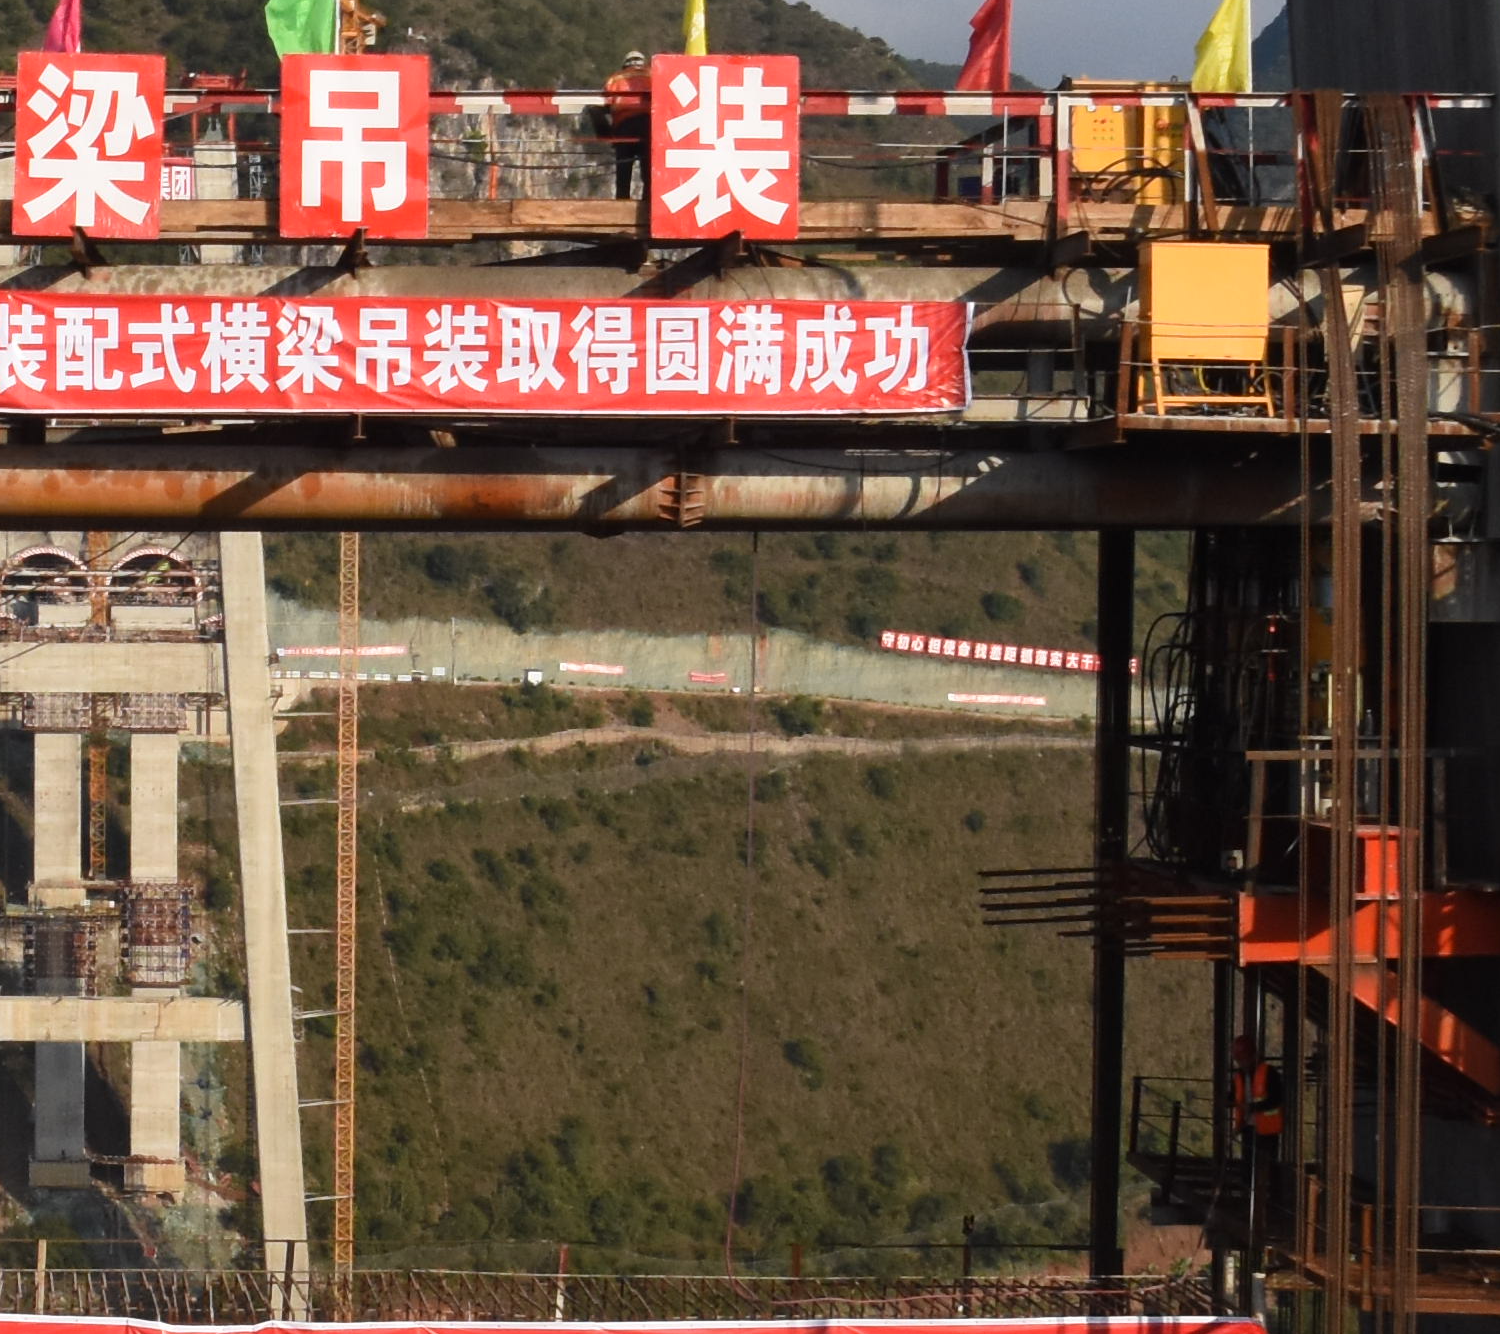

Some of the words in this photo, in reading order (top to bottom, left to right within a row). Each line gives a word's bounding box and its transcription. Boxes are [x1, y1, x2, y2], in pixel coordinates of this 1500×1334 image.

[23, 64, 155, 227] 梁
[302, 70, 407, 221] 吊
[661, 66, 790, 227] 装
